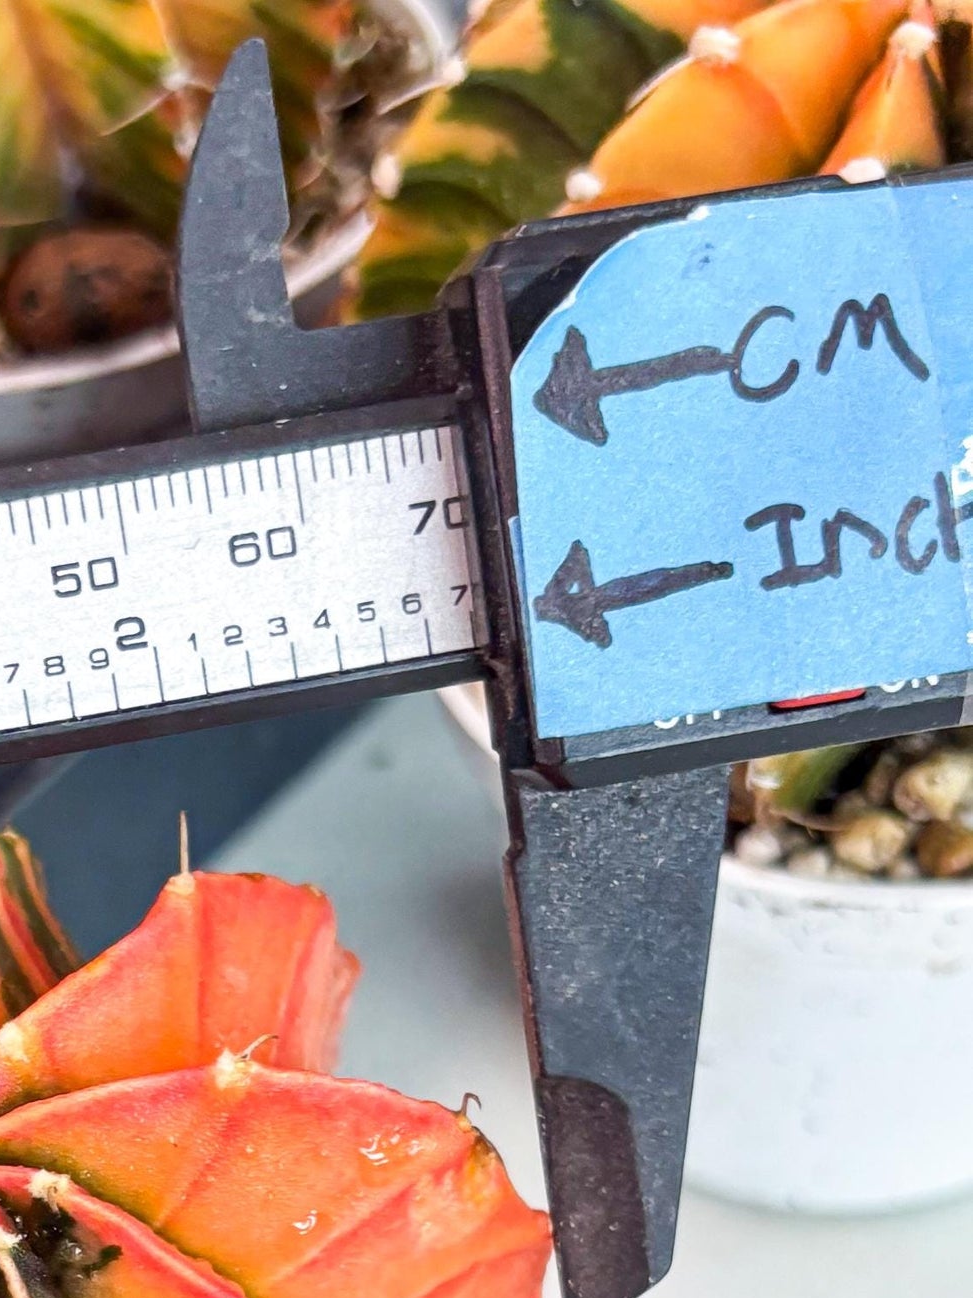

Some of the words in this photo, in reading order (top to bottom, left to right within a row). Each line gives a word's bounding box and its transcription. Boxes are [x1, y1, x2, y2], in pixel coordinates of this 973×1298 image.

[729, 292, 930, 402] CM
[51, 557, 119, 598] 50
[229, 526, 297, 567] 60
[4, 664, 19, 683] 7
[44, 656, 64, 677] 8
[89, 648, 109, 669] 9
[115, 617, 148, 651] 2
[189, 633, 197, 651] 1
[224, 625, 243, 646] 2
[269, 617, 287, 636] 3
[314, 609, 331, 629] 4
[358, 601, 376, 621] 5
[402, 593, 422, 615] 6
[452, 585, 467, 606] 7
